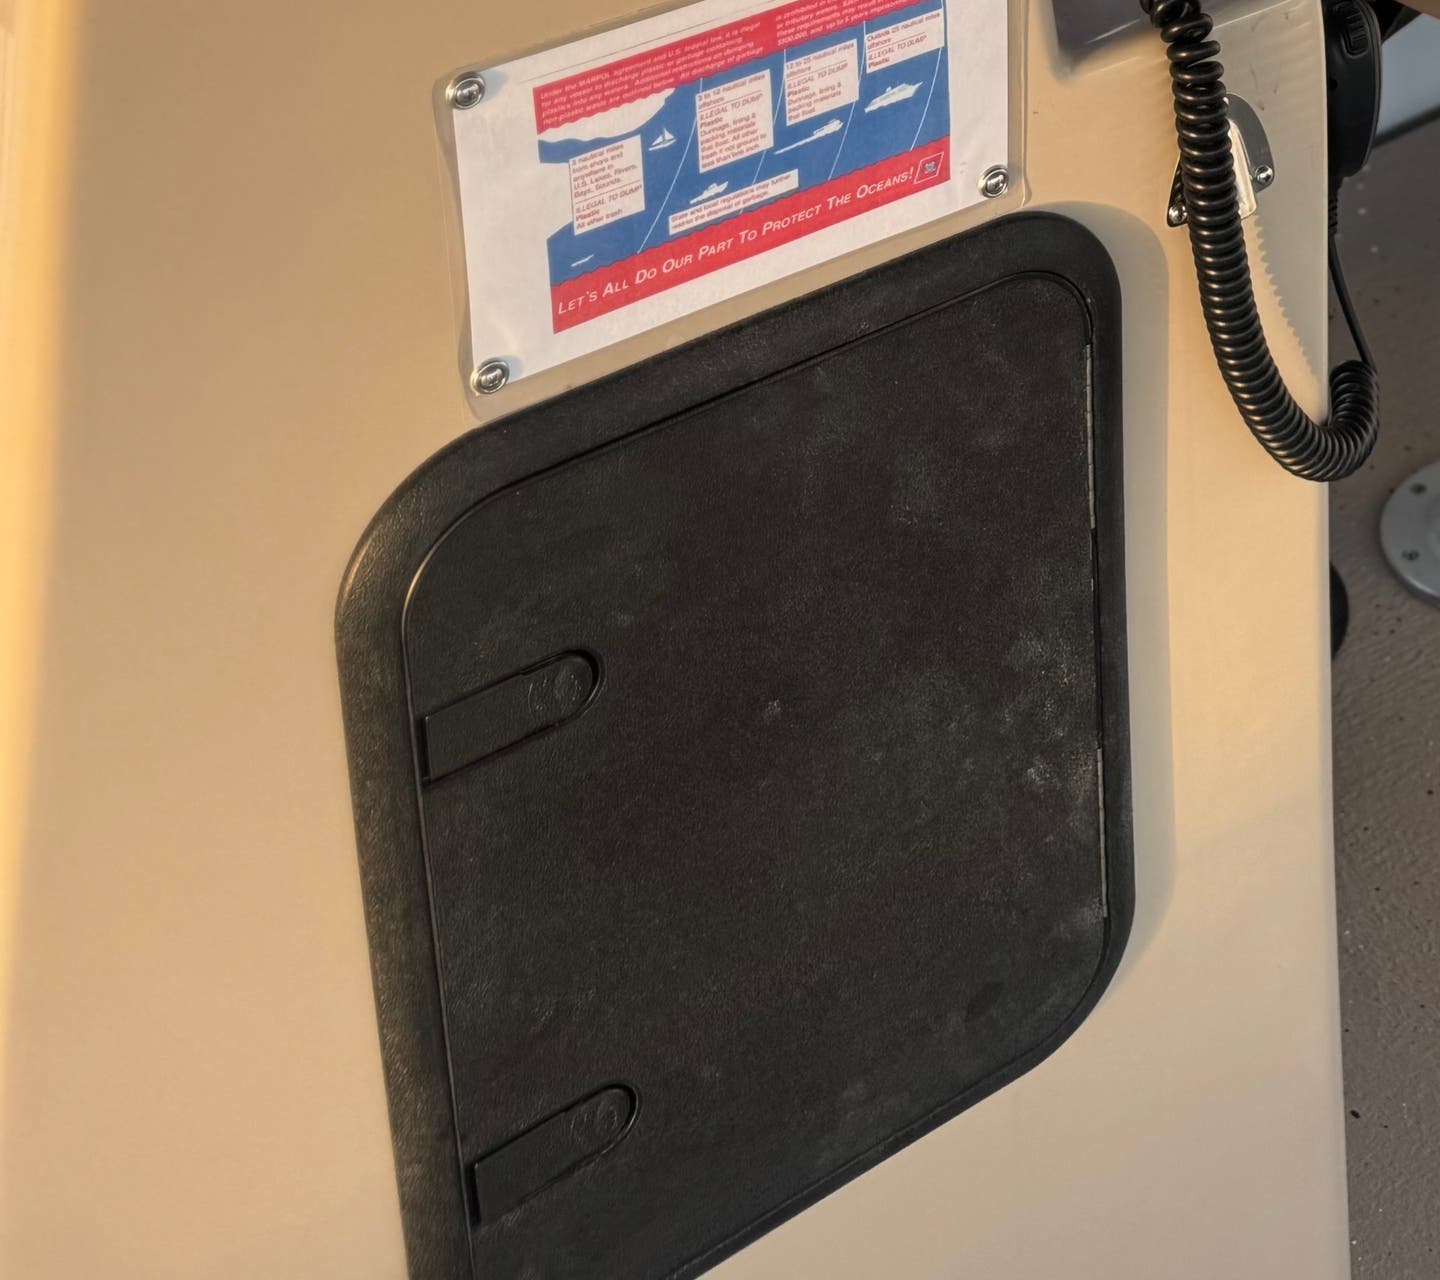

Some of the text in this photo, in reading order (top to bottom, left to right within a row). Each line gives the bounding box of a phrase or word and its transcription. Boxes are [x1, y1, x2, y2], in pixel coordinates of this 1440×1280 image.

[868, 34, 927, 60] ILLEGAL TO DUMP
[787, 61, 848, 89] ILLEGAL TO DUMP
[699, 92, 762, 120] ILLEGAL TO DUMP
[575, 183, 642, 214] ILLEGAL TO DUMP
